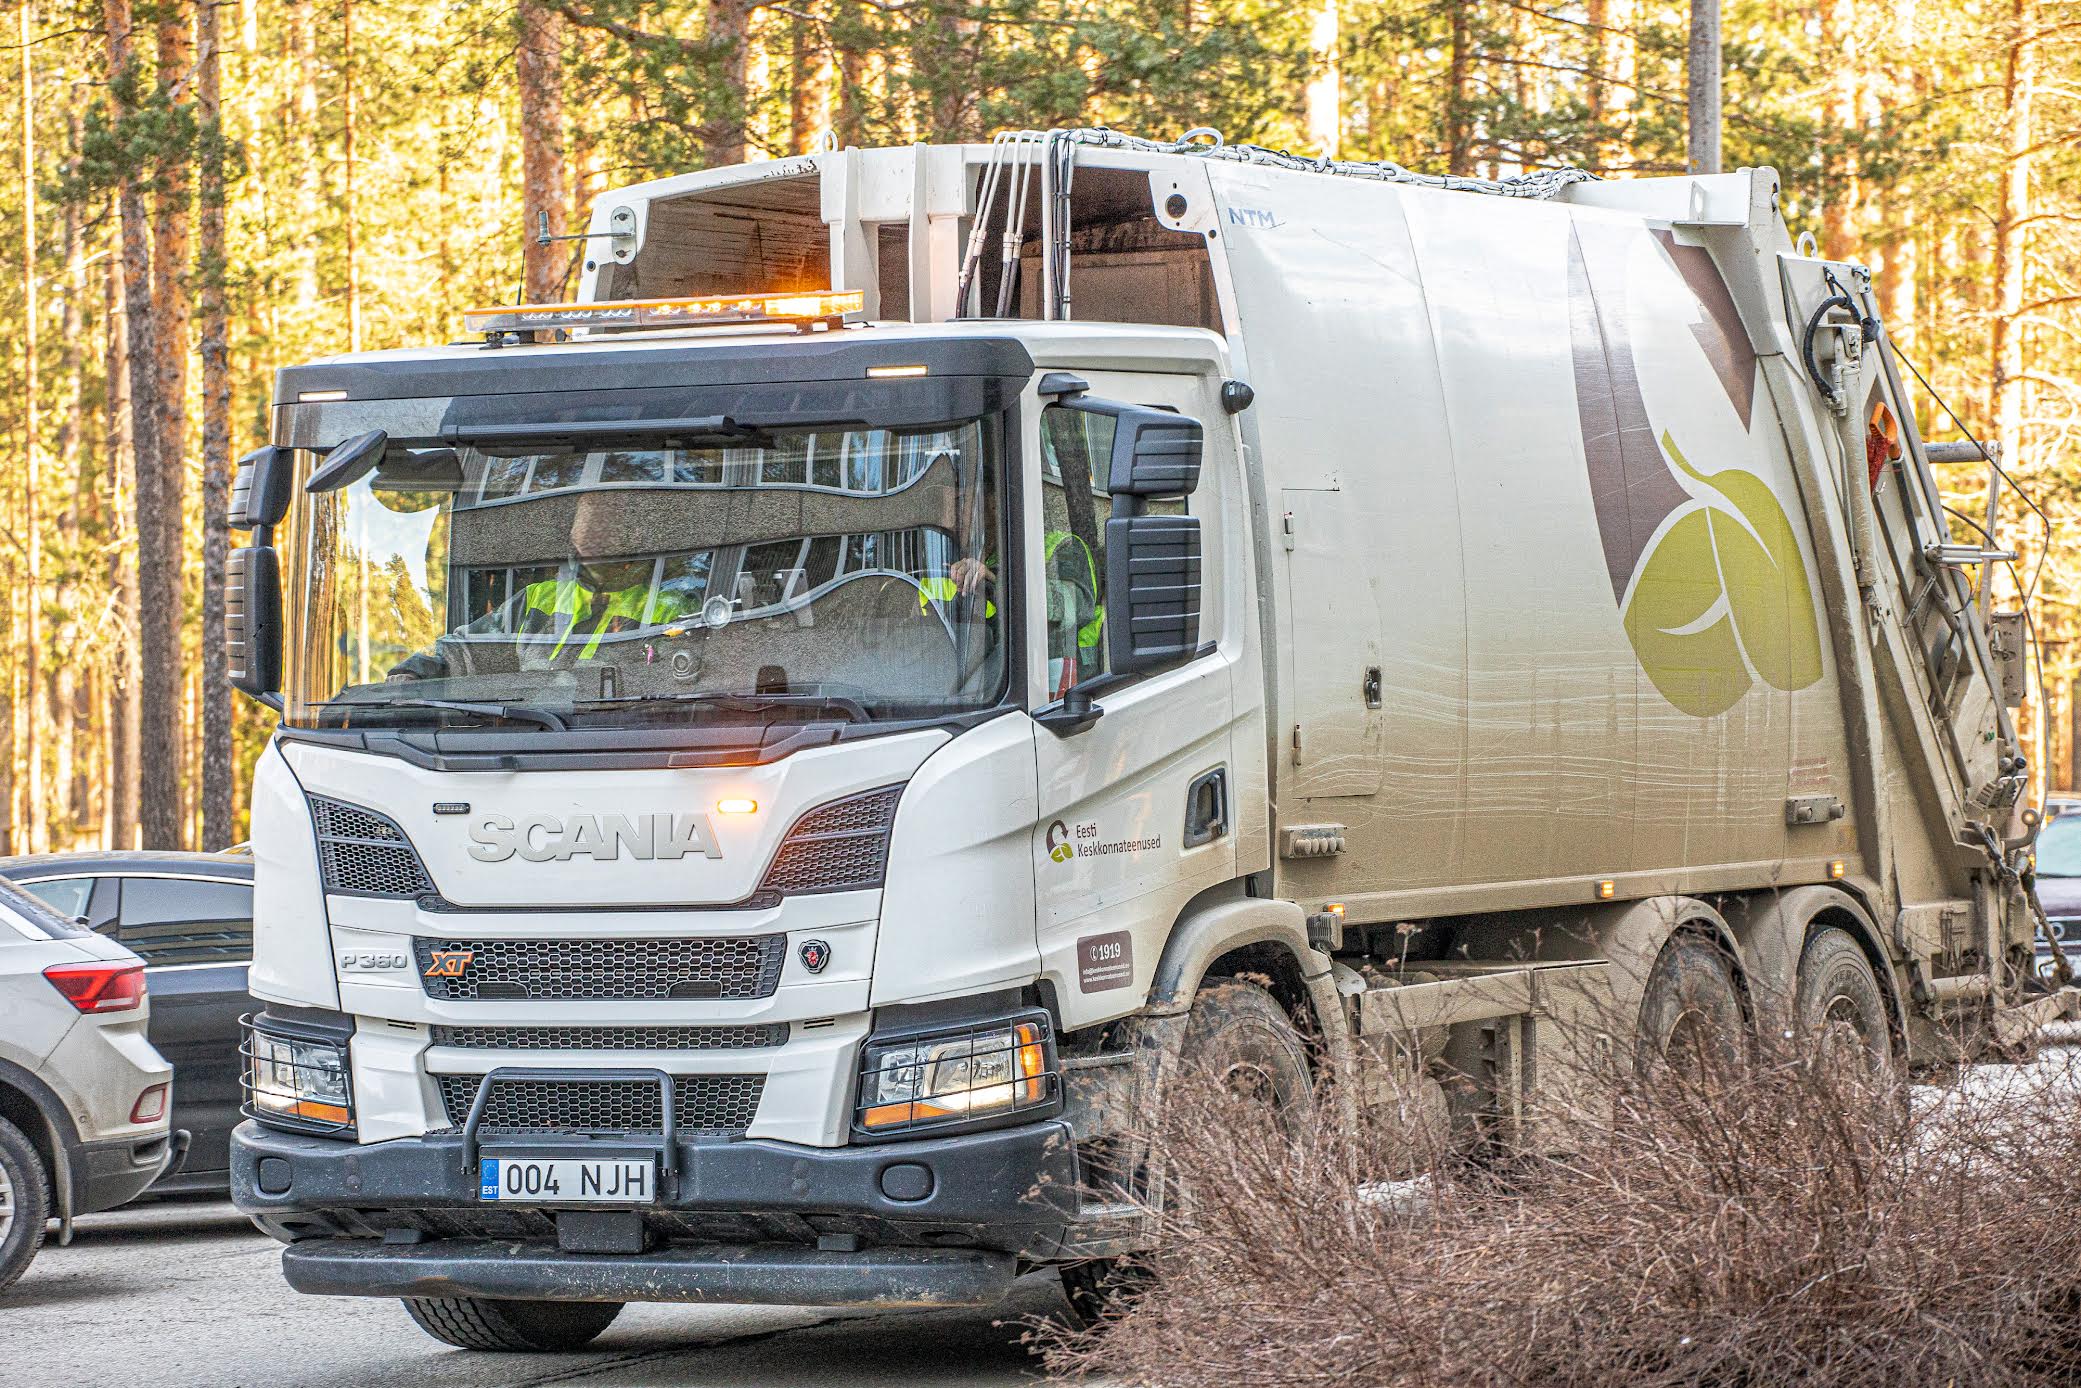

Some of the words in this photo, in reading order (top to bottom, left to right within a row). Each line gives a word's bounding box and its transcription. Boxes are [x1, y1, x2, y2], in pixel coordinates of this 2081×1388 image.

[1228, 207, 1277, 227] NTM
[467, 813, 723, 863] SCANIA
[1076, 823, 1097, 839] Eesti
[1077, 834, 1161, 858] Keskkonnateenused
[340, 953, 357, 968] P
[360, 953, 408, 969] 360
[1099, 942, 1121, 960] 1919
[424, 951, 474, 977] XT
[507, 1163, 560, 1195] 004
[581, 1164, 645, 1196] NJH
[482, 1185, 499, 1195] EST
